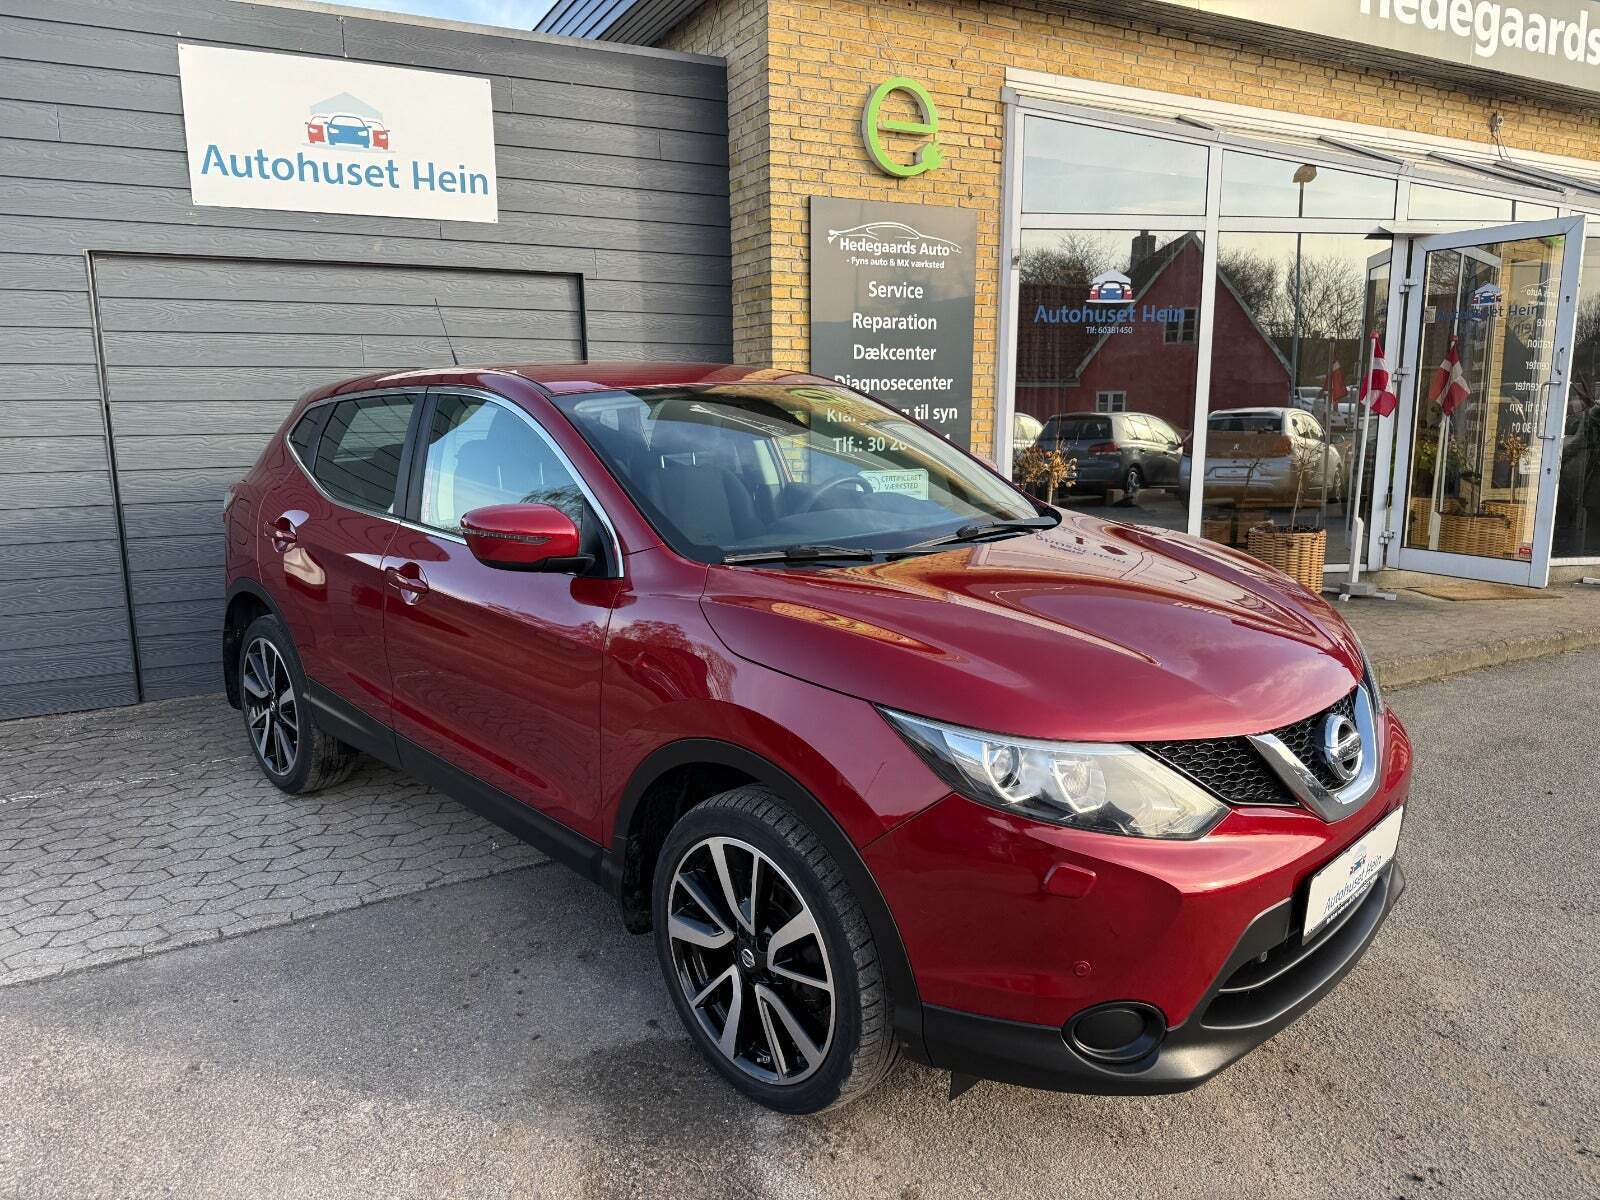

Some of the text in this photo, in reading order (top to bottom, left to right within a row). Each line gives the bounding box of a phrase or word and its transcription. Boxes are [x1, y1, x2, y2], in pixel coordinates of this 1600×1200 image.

[201, 144, 489, 195] Autohuset Hein
[840, 237, 950, 256] Hedegaards Auto
[851, 257, 869, 266] Fyns
[870, 258, 888, 266] auto
[889, 259, 896, 267] &
[896, 259, 910, 268] MX
[911, 260, 945, 269] værksted
[868, 281, 924, 299] Service
[852, 312, 937, 333] Reparation
[1034, 304, 1185, 324] Autohuset Hein
[853, 344, 937, 361] Dækcenter
[914, 404, 929, 420] til
[932, 407, 958, 424] syn
[833, 436, 863, 453] Tlf.:
[867, 436, 885, 452] 30
[1323, 867, 1364, 915] Autohuset
